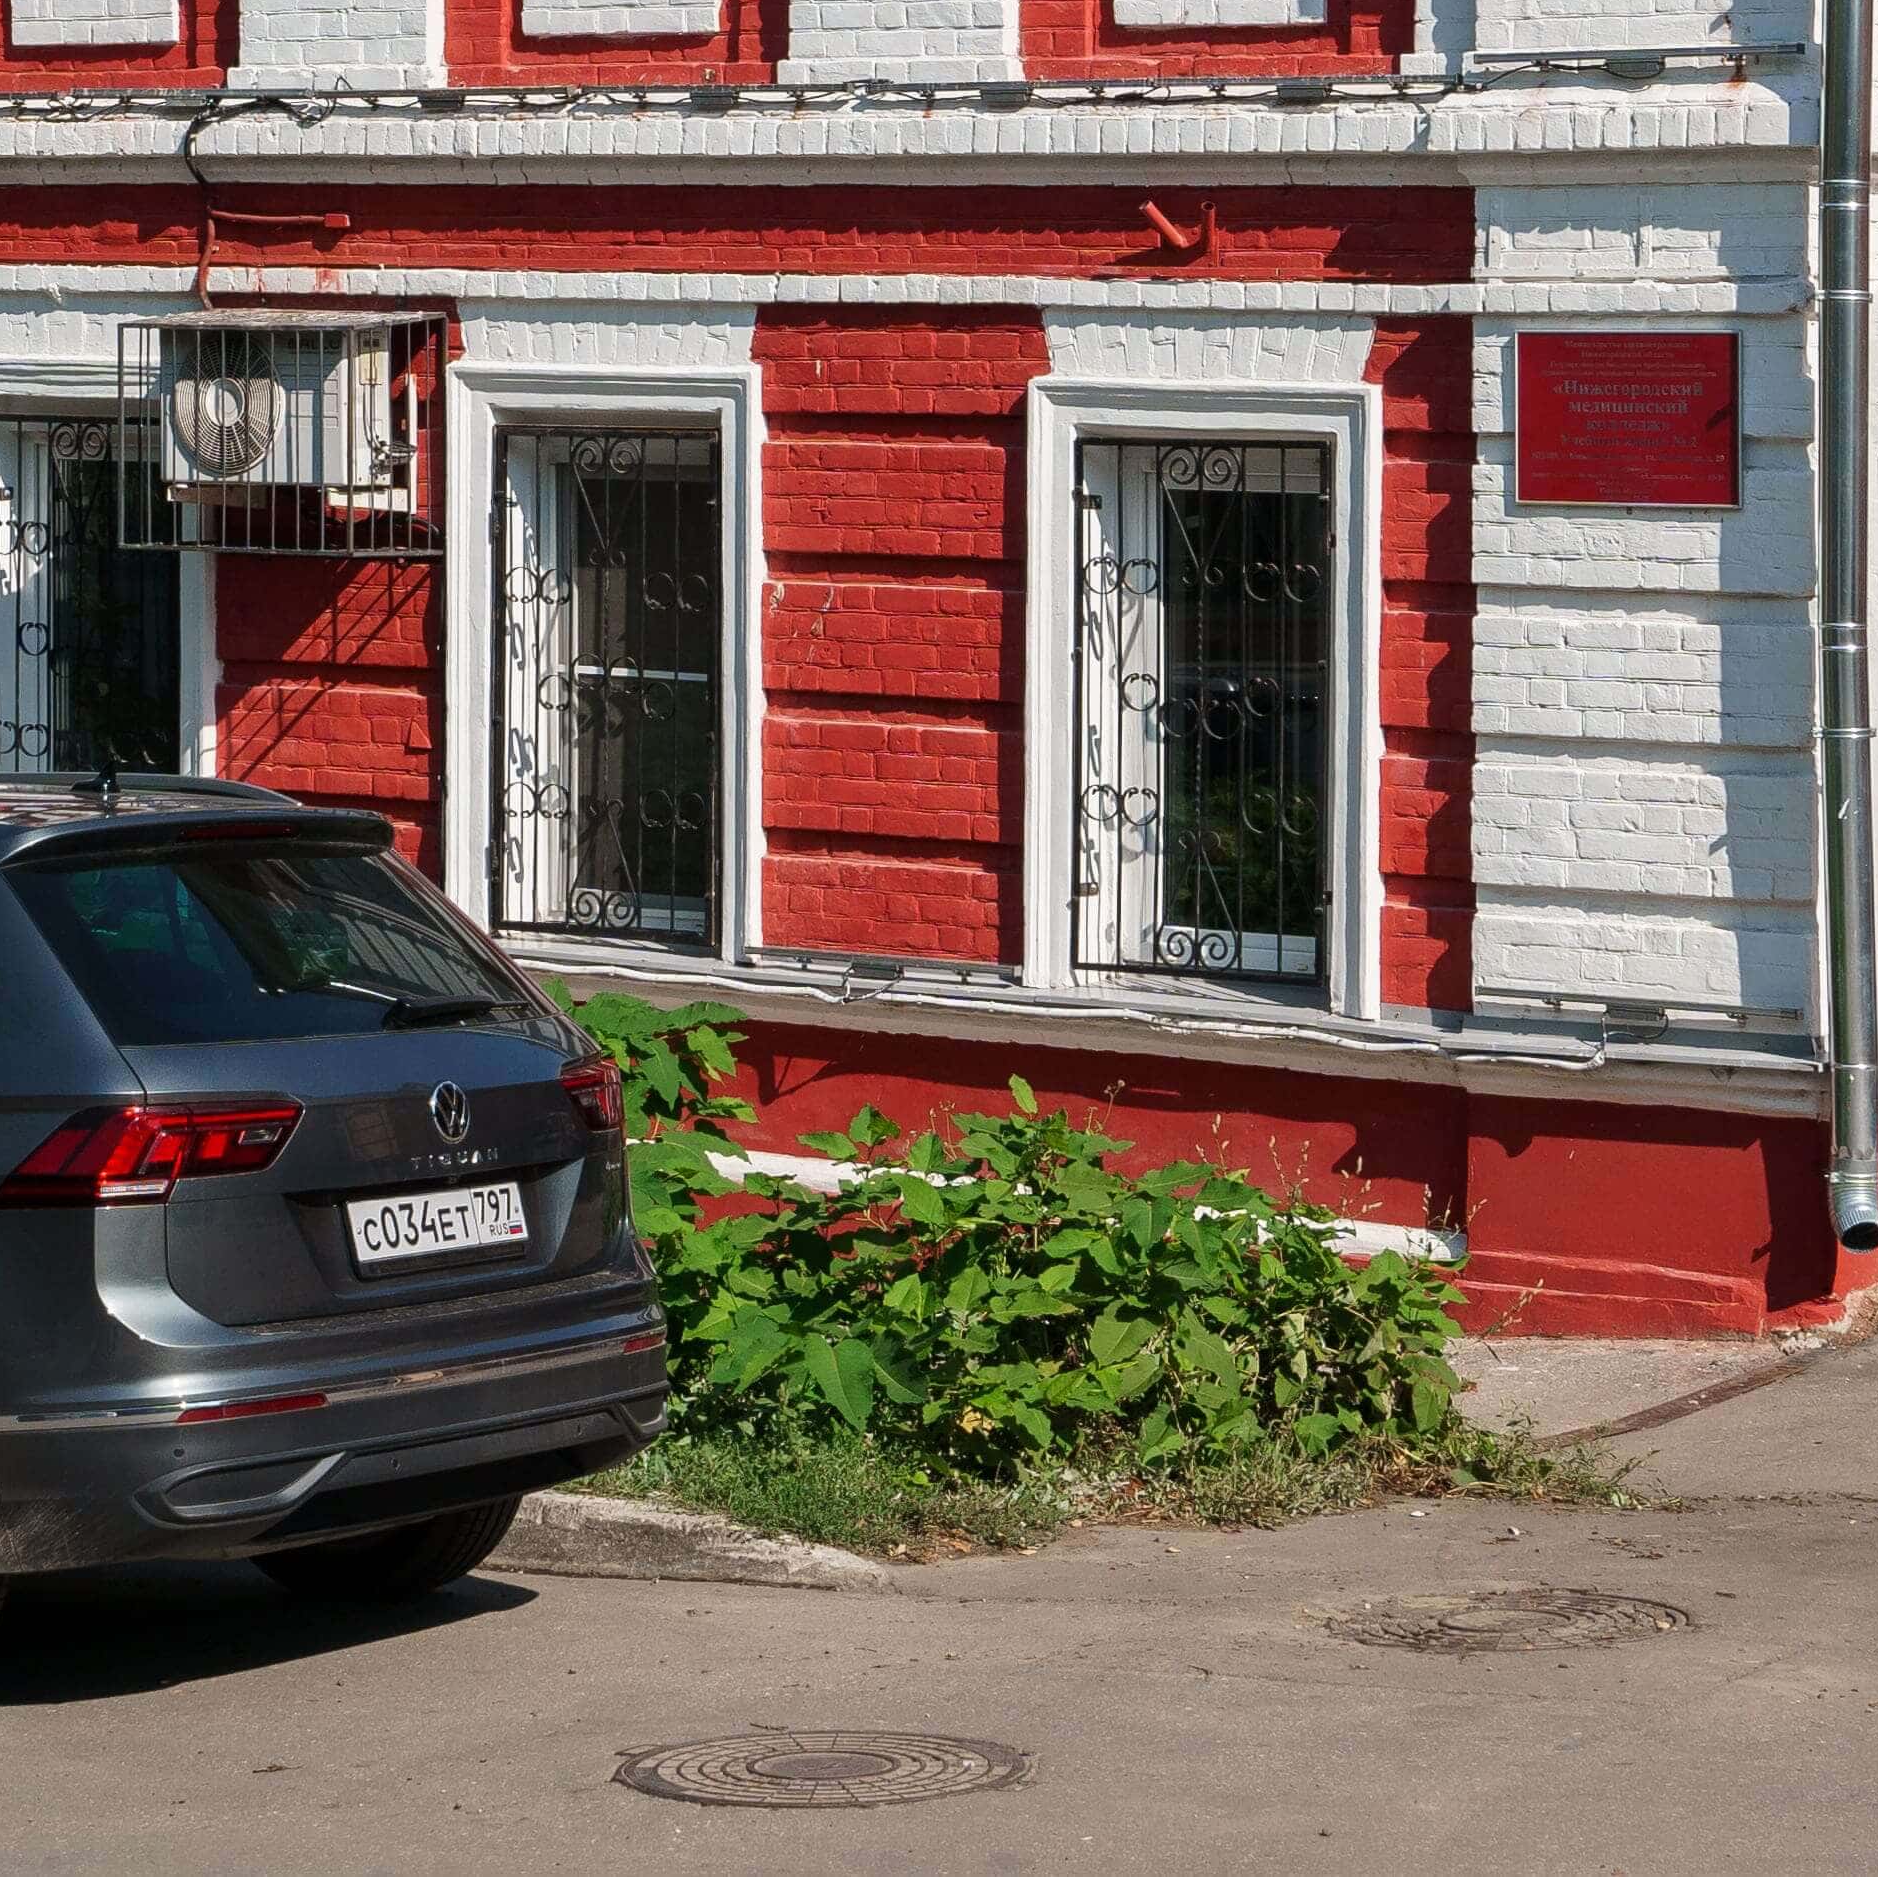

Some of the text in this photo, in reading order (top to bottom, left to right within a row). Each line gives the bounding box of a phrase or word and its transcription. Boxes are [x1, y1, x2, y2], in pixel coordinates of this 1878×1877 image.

[410, 1147, 498, 1170] TIGUAN
[473, 1188, 512, 1225] 797
[489, 1222, 509, 1237] RUS
